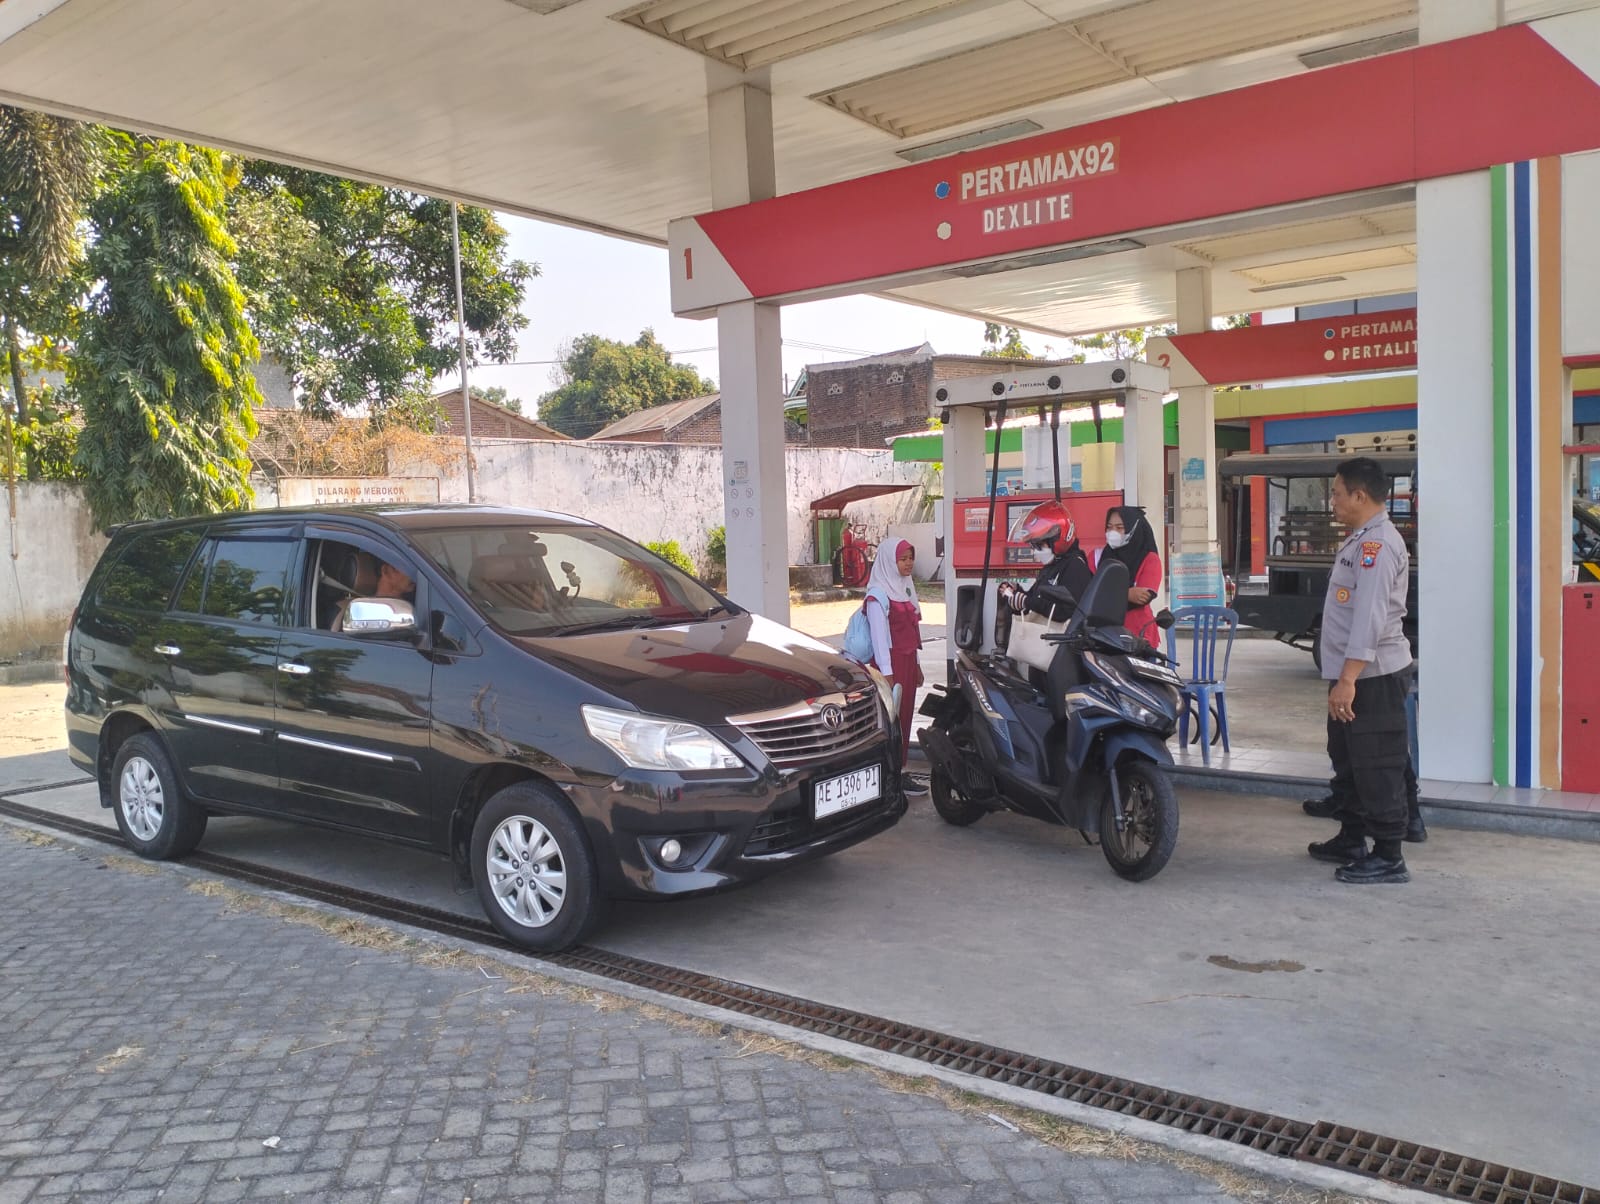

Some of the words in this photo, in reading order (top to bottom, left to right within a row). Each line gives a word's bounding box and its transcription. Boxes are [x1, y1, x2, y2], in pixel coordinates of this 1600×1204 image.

[961, 142, 1116, 199] PERTAMAX92
[984, 194, 1071, 234] DEXLITE
[682, 248, 694, 280] 1
[1341, 319, 1416, 338] PERTAMA
[317, 487, 362, 495] DILARANG
[364, 487, 405, 495] MEROKOK
[818, 782, 831, 805] AE
[837, 772, 861, 799] 1396
[865, 767, 877, 789] PI
